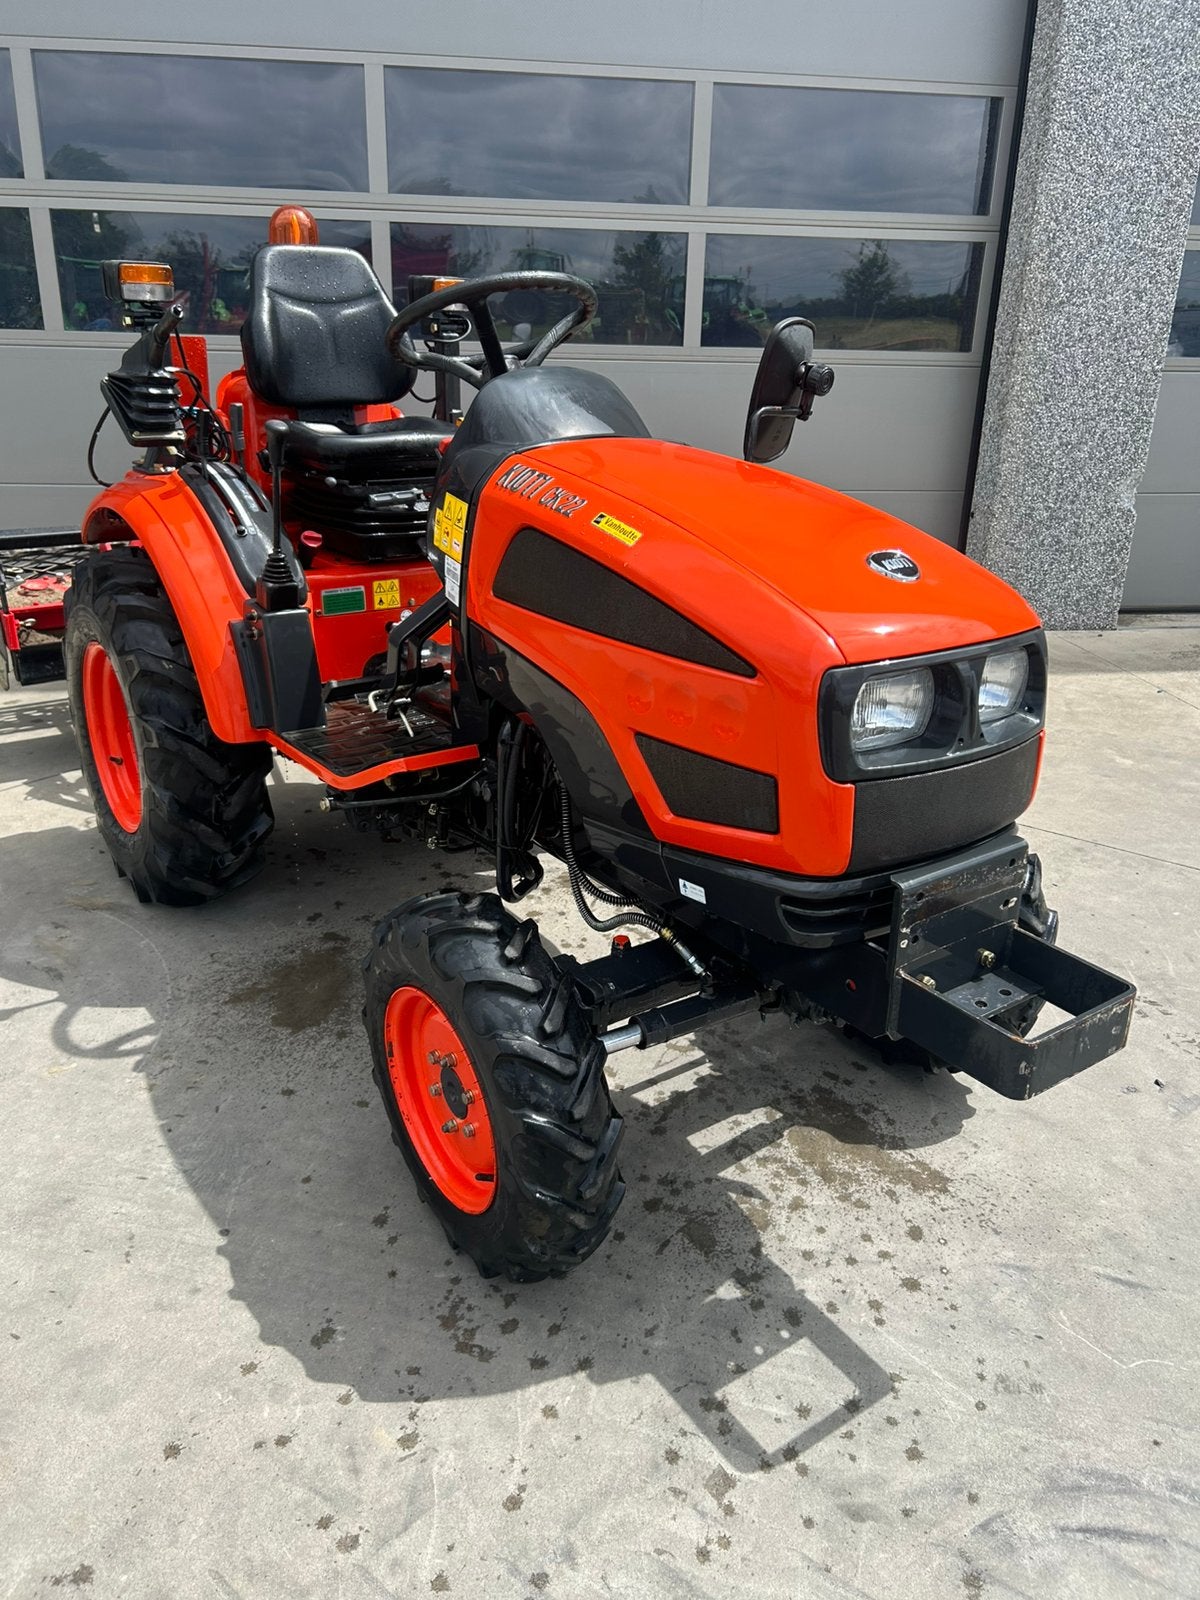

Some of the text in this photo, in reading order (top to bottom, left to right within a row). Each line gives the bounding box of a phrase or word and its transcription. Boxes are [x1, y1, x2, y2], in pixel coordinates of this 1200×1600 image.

[496, 463, 588, 518] KIOTI CK22
[604, 517, 638, 541] Vanhoutte
[881, 557, 913, 571] KIOTI
